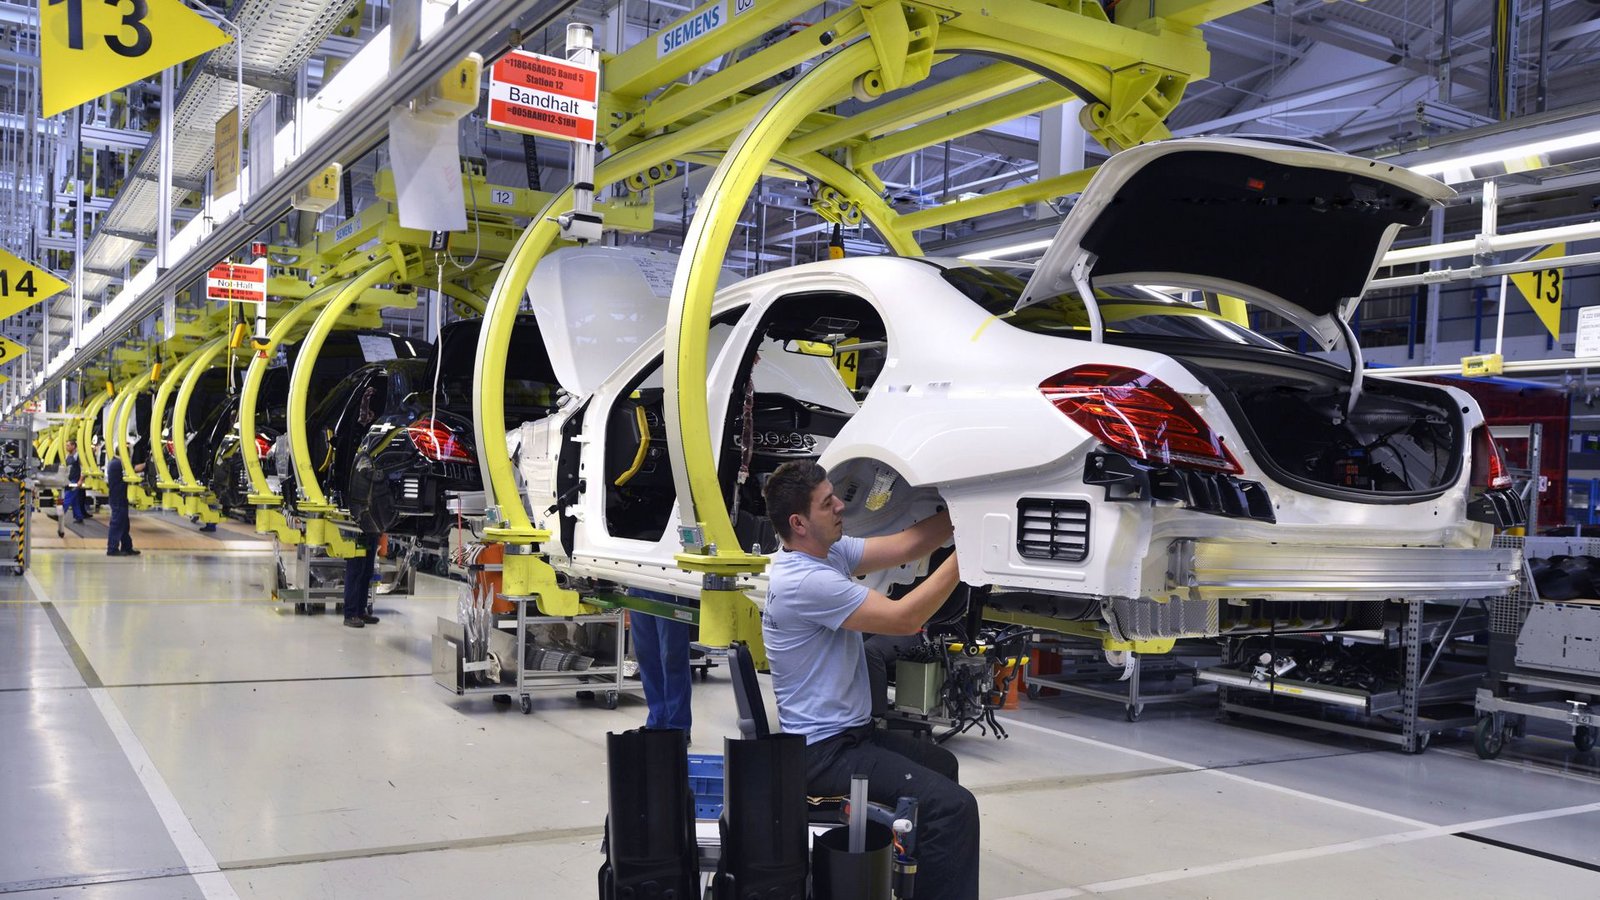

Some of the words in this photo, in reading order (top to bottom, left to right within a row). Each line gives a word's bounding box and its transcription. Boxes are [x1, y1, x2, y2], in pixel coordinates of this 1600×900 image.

[48, 0, 153, 57] 13
[663, 5, 720, 53] SIEMENS
[526, 74, 554, 89] Station
[555, 80, 564, 90] 12
[557, 69, 578, 81] Band
[578, 73, 584, 82] 5
[509, 86, 579, 115] Bandhalt
[496, 191, 510, 204] 12
[0, 269, 38, 298] 14
[217, 279, 253, 289] Not-Halt
[1533, 268, 1560, 304] 13
[836, 352, 856, 373] 14
